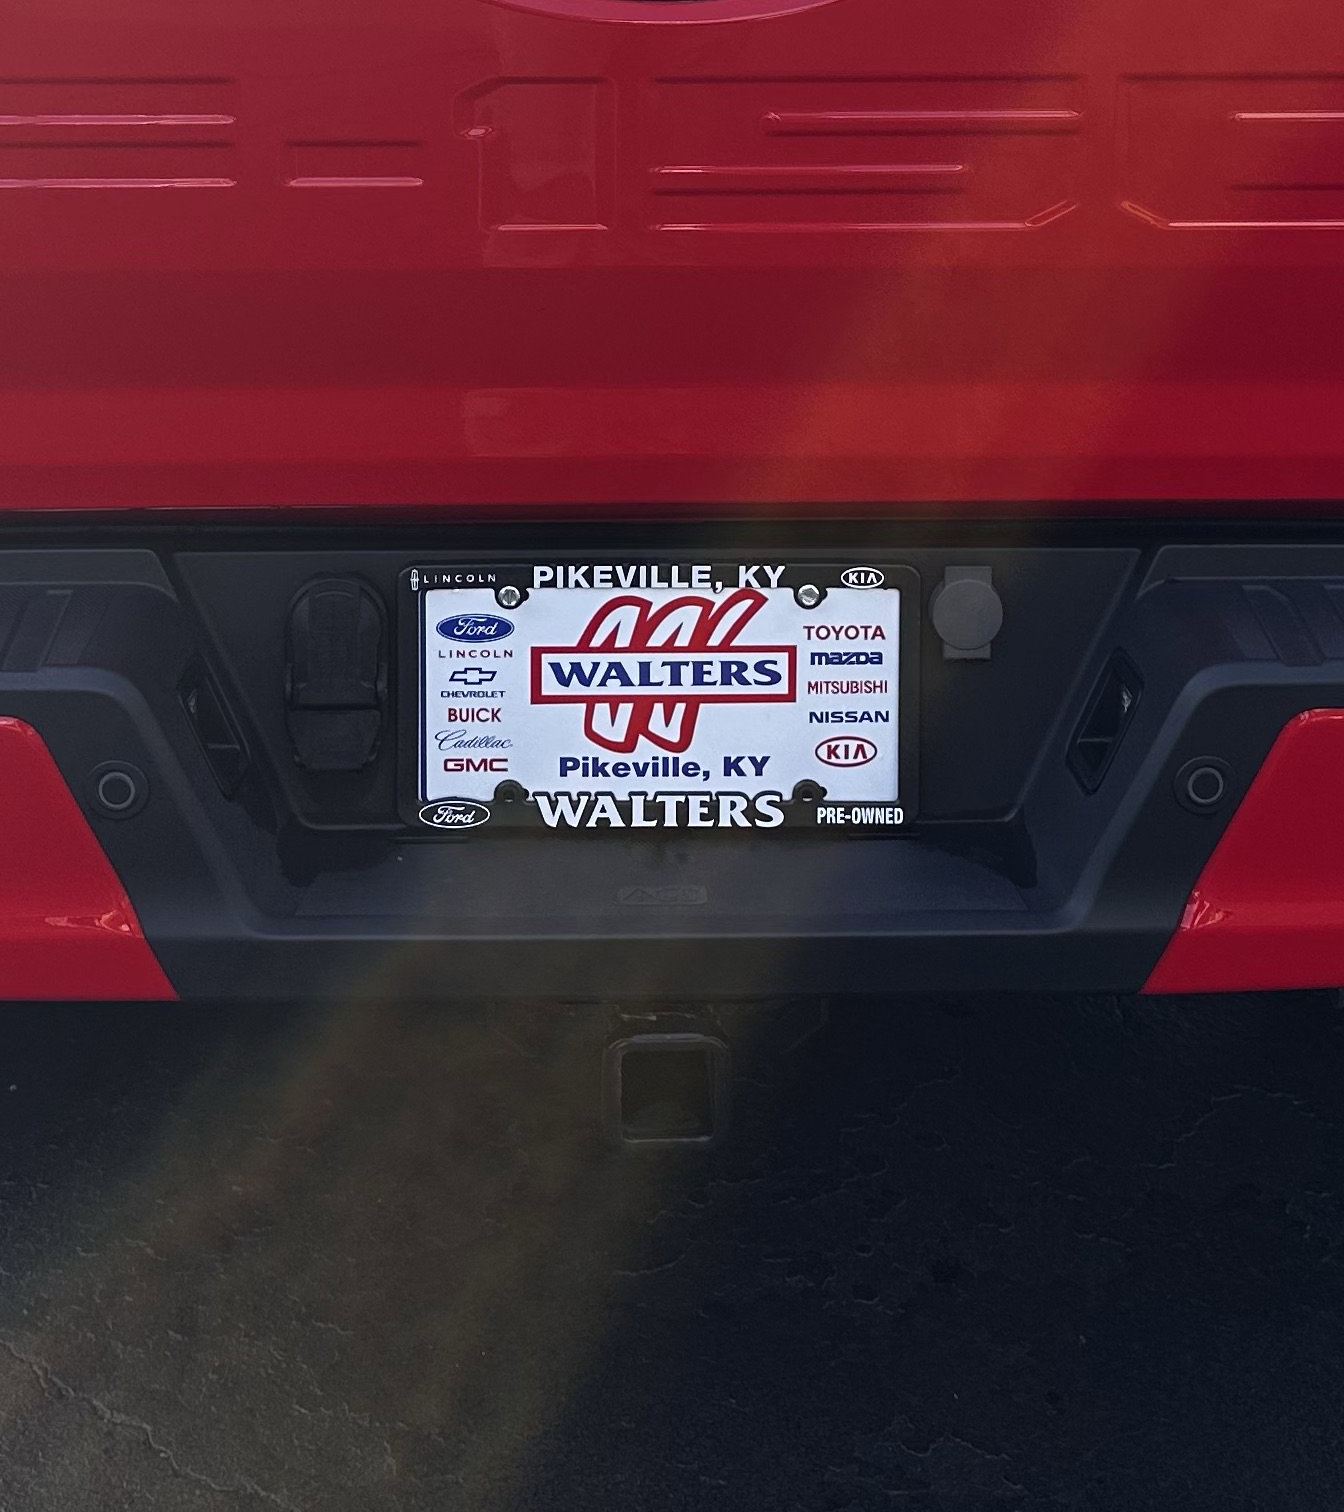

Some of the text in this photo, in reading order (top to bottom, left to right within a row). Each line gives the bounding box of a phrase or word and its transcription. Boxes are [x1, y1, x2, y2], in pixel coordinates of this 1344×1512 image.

[423, 574, 497, 584] LINCOLN
[533, 565, 786, 594] PIKEVILLE, KY
[848, 571, 878, 584] KIA
[453, 616, 499, 637] Ford
[803, 625, 886, 640] TOYOTA
[438, 649, 514, 659] LINCOLN
[547, 659, 783, 688] WALTERS
[440, 690, 506, 698] CHEVROLET
[807, 680, 888, 695] MITSUBISHI
[447, 707, 502, 723] BUICK
[809, 710, 890, 724] NISSAN
[434, 729, 514, 751] Cadillac
[826, 743, 868, 760] KIA
[443, 758, 509, 772] GMC
[559, 755, 771, 781] Pikeville, KY
[433, 804, 476, 826] Ford
[534, 792, 785, 828] WALTERS
[816, 807, 905, 825] PRE-OWNED
